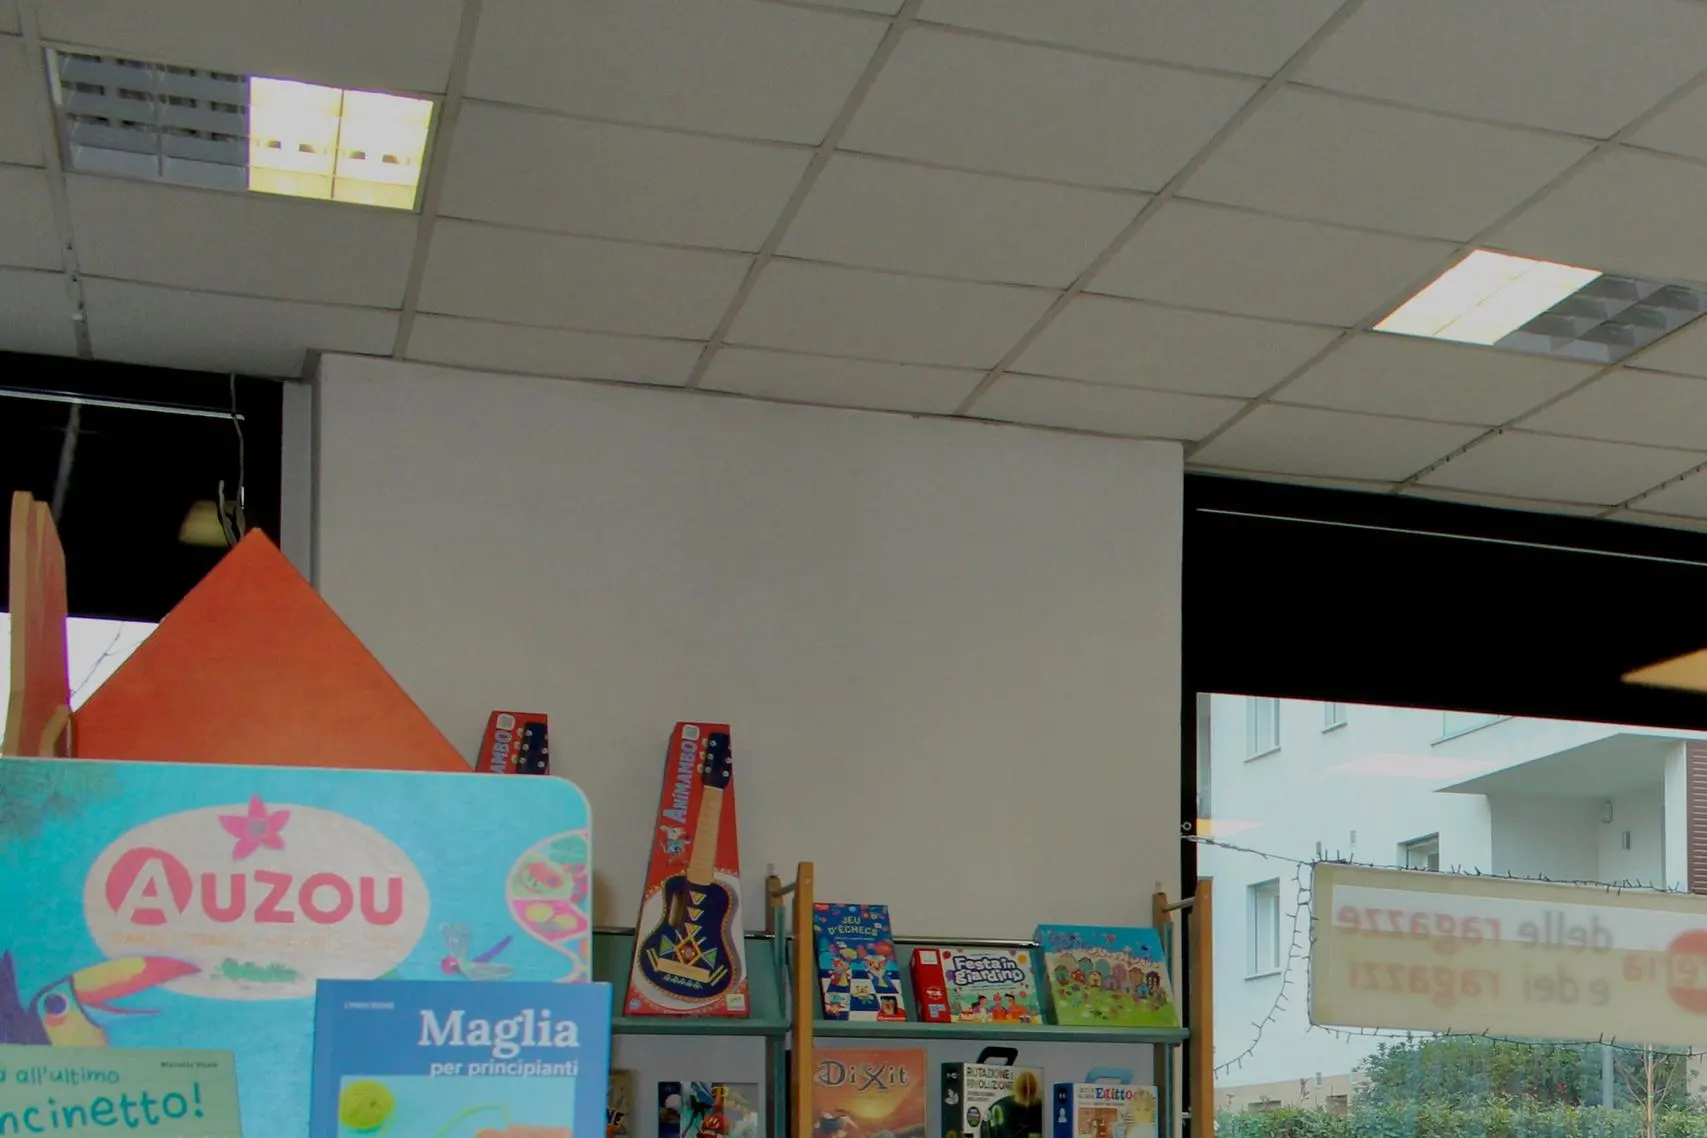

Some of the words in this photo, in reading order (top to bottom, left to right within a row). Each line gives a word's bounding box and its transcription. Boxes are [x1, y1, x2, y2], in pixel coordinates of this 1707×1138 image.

[105, 847, 404, 927] AUZOU
[842, 915, 861, 926] JEU
[954, 956, 1001, 971] Festa
[1003, 956, 1016, 970] in
[954, 968, 1024, 986] giardino
[418, 1009, 580, 1058] Maglia
[16, 1066, 120, 1087] all'ultimo
[430, 1061, 463, 1077] per
[469, 1058, 579, 1077] principianti
[1095, 1087, 1133, 1101] Egitto
[0, 1082, 205, 1136] ncinetto!
